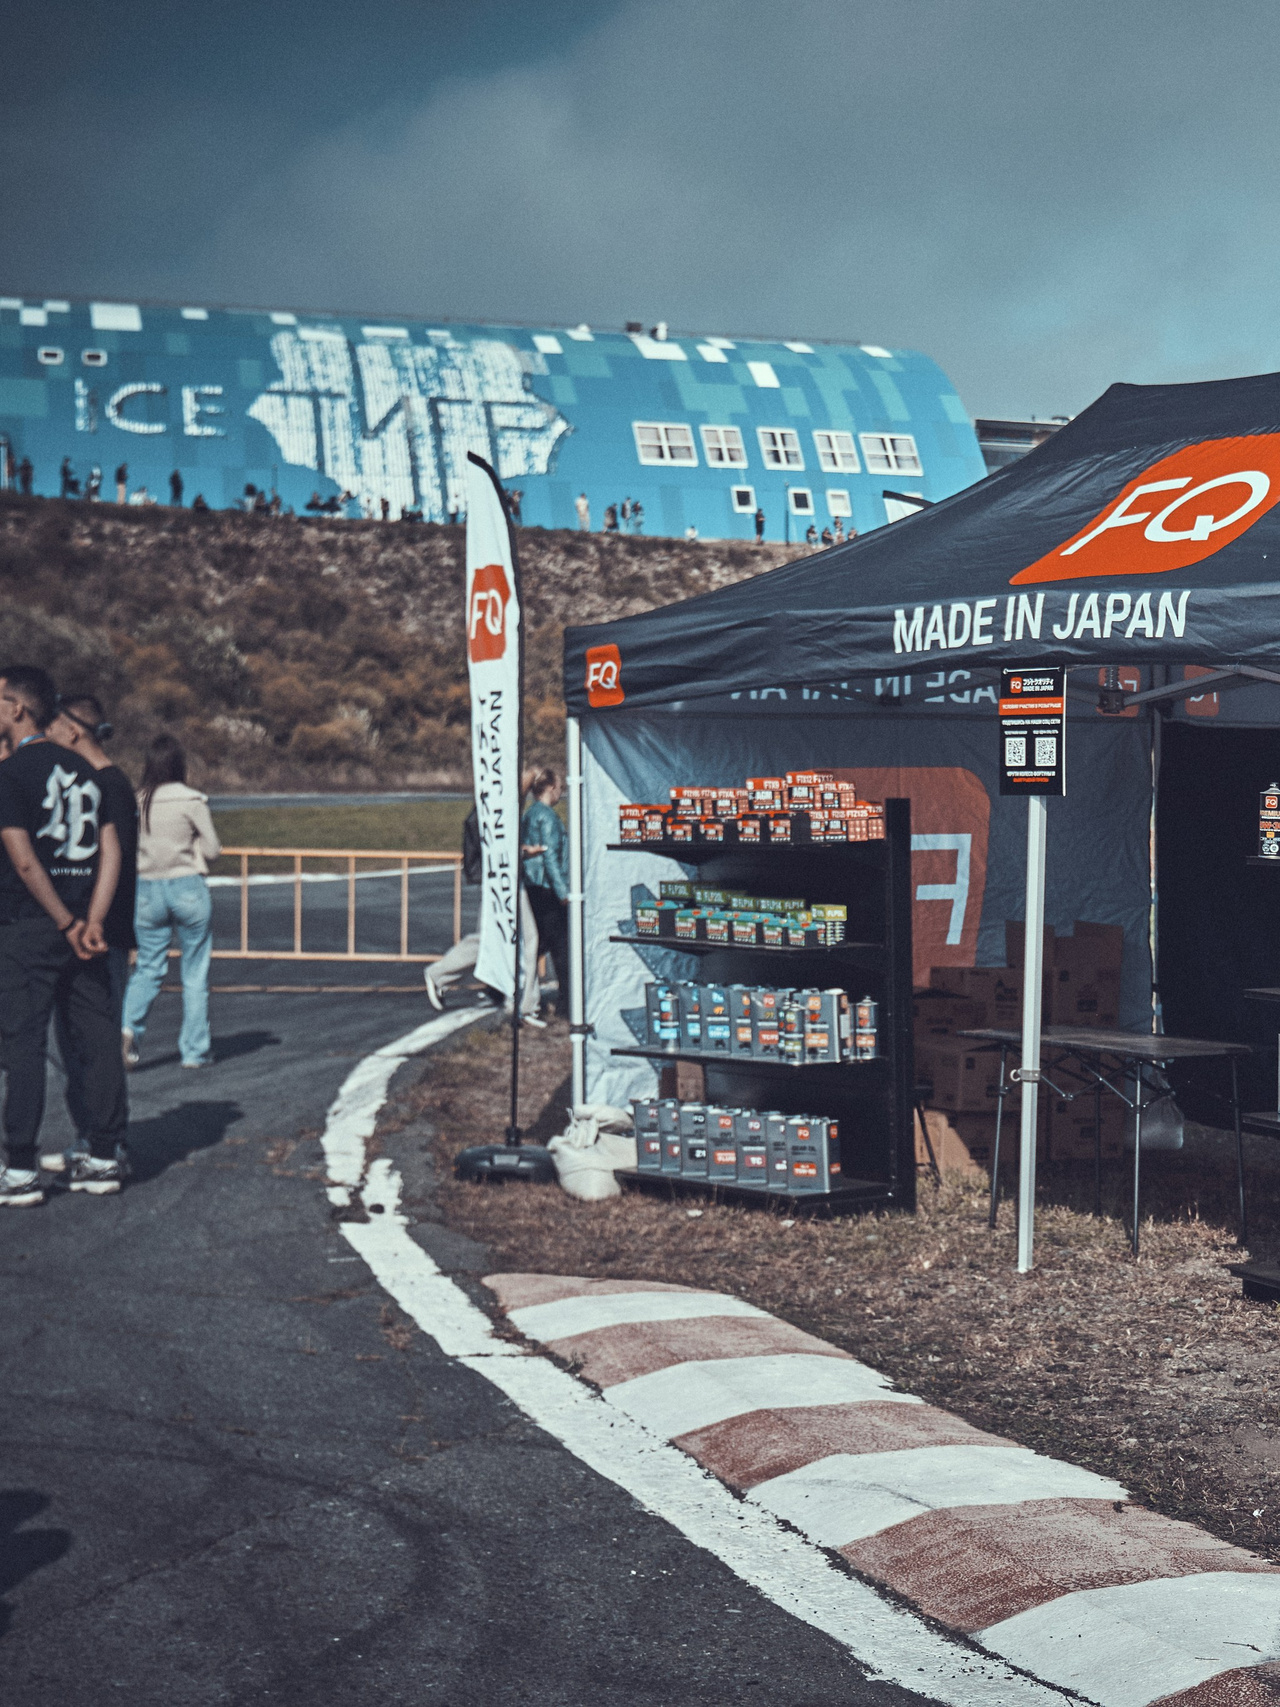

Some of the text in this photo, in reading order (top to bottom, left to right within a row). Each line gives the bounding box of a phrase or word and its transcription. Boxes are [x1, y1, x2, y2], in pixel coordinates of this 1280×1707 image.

[75, 378, 226, 436] ICE
[1060, 471, 1271, 556] FQ
[471, 589, 502, 640] FQ
[893, 591, 1192, 653] MADE IN JAPAN
[588, 661, 618, 692] FQ
[1011, 681, 1021, 689] FQ
[490, 691, 503, 795] JAPAN
[494, 809, 505, 839] IN
